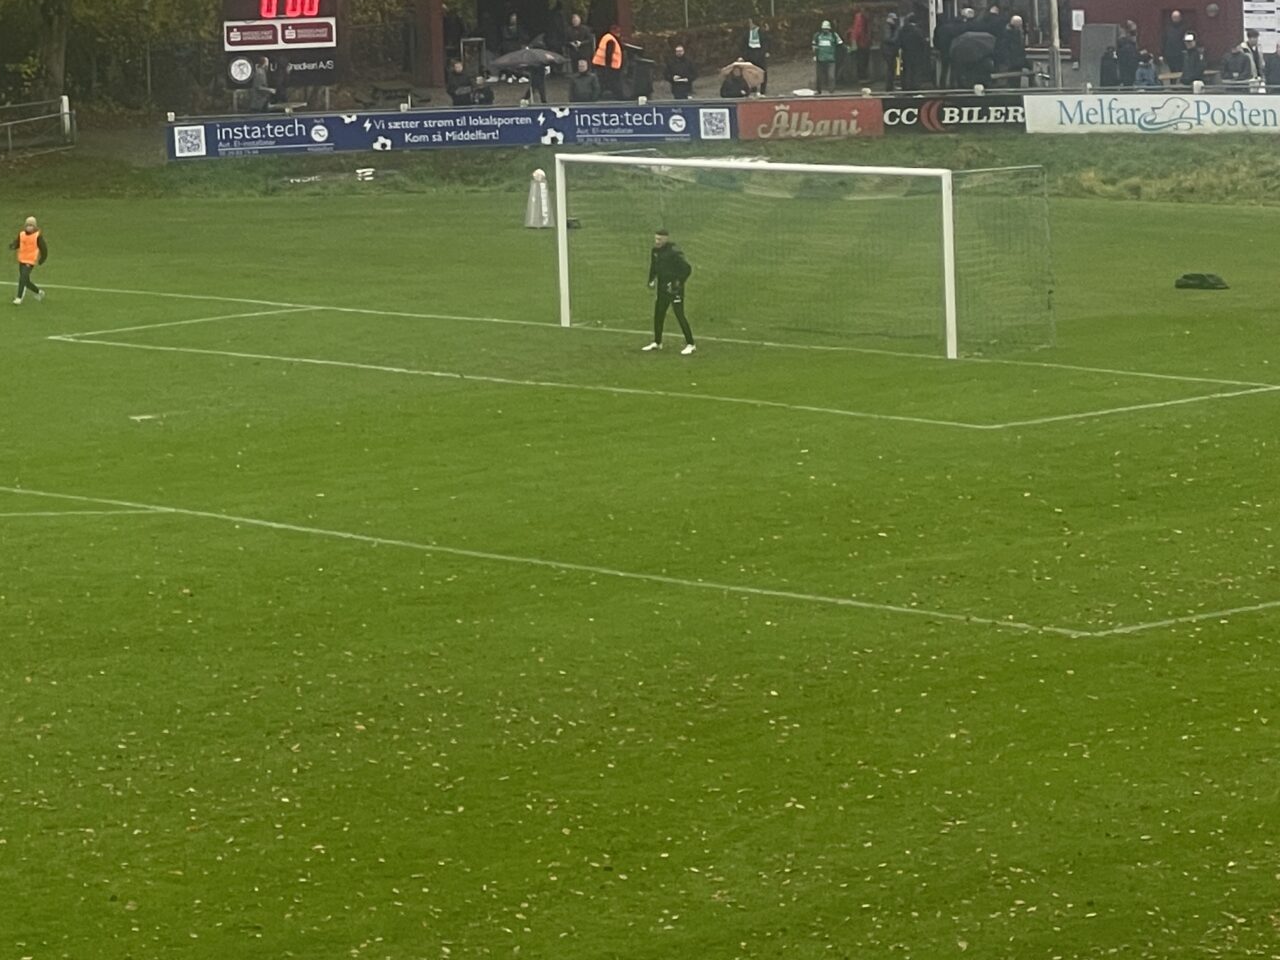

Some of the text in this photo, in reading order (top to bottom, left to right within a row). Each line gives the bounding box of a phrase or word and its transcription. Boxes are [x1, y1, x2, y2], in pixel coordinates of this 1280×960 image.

[373, 115, 532, 129] Vi sætter strøm til lokalsporten
[575, 107, 664, 127] insta:tech
[883, 106, 1025, 125] CC BILER
[1057, 98, 1278, 126] Melfar Posten
[216, 118, 306, 140] insta:tech
[758, 109, 862, 138] Albani
[405, 130, 500, 143] Kom så Middelfart!
